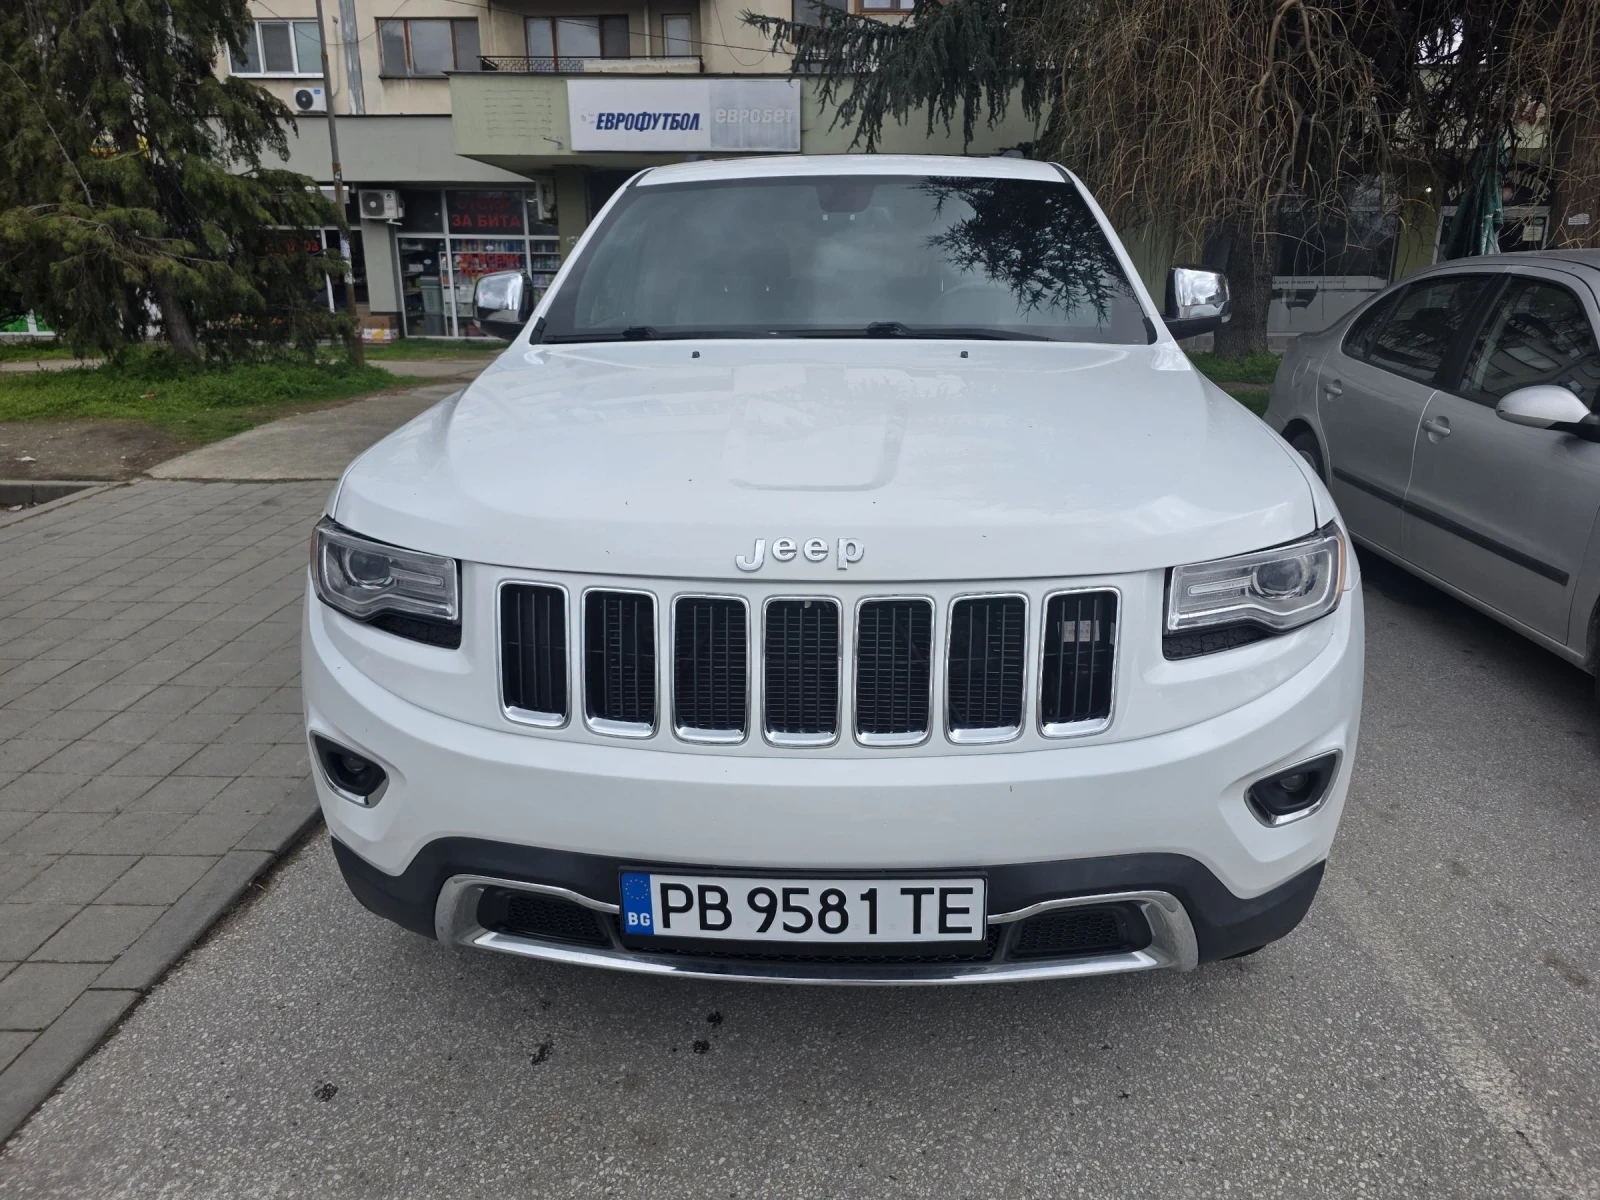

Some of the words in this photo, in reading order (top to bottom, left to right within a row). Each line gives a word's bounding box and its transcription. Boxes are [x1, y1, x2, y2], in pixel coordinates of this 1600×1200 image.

[596, 111, 701, 132] ЕВРОФУТБОЛ
[452, 214, 473, 228] ЗА
[477, 214, 522, 228] БИТА
[478, 253, 520, 264] ВСЕКИ
[735, 537, 865, 573] Jeep
[659, 882, 733, 931] PB
[747, 886, 878, 935] 9581
[900, 887, 974, 934] TE
[627, 911, 651, 927] BG
